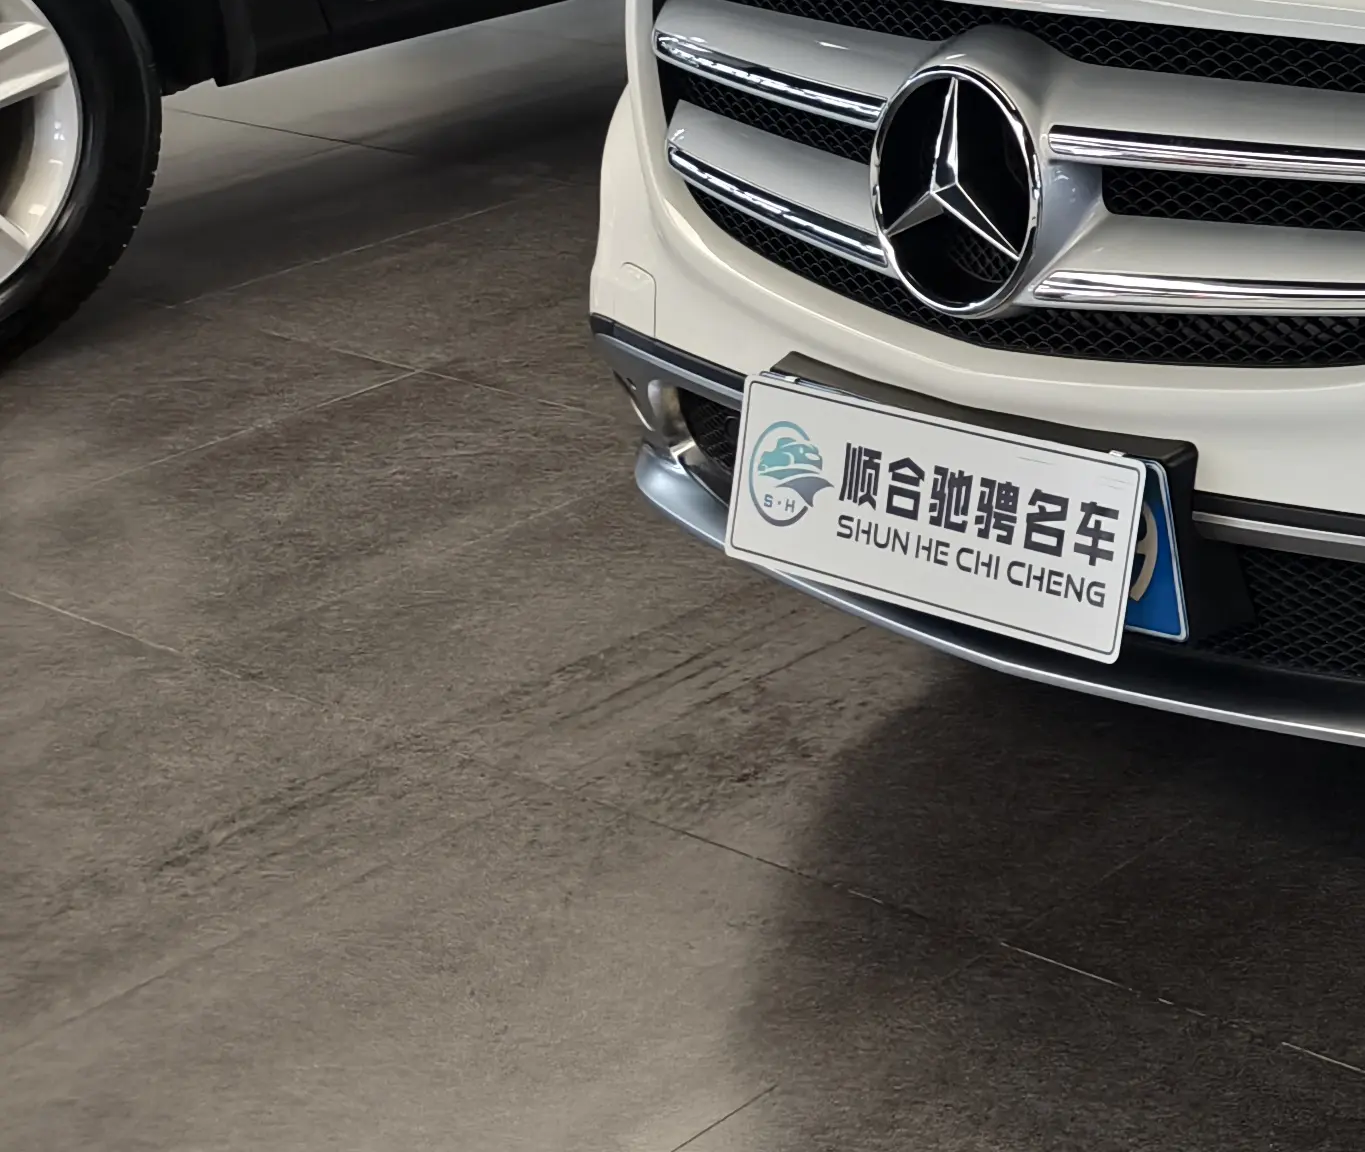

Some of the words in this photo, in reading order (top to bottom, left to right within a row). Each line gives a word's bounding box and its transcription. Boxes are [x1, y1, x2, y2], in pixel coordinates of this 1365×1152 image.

[838, 442, 1120, 567] 顺合驰骋名车
[837, 514, 910, 556] SHUN
[915, 534, 950, 567] HE
[956, 547, 1001, 580] CHI
[1007, 560, 1106, 608] CHENG
